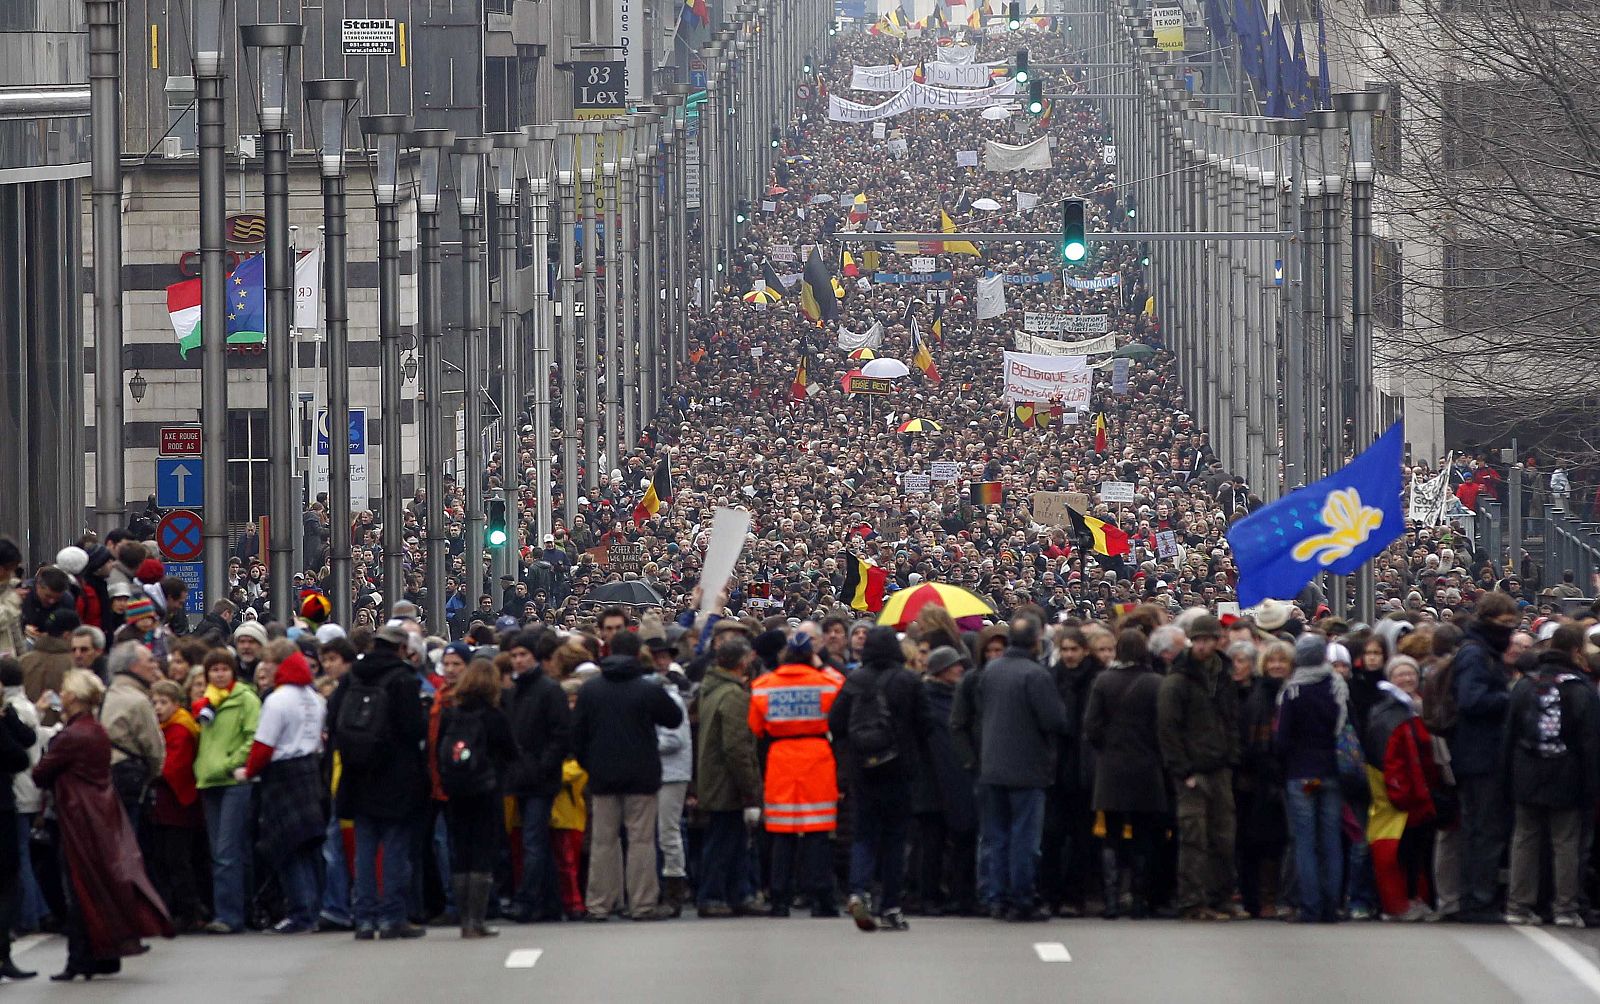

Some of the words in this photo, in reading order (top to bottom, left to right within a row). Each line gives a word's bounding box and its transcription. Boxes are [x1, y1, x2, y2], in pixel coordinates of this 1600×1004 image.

[587, 66, 611, 84] 83
[580, 86, 619, 104] Lex
[902, 274, 933, 283] LAND
[1011, 361, 1069, 383] BELGIQUE
[873, 381, 889, 391] BEST
[610, 545, 631, 554] SCHEER
[632, 545, 640, 554] JE
[195, 591, 204, 600] 13
[769, 690, 818, 703] POLICE
